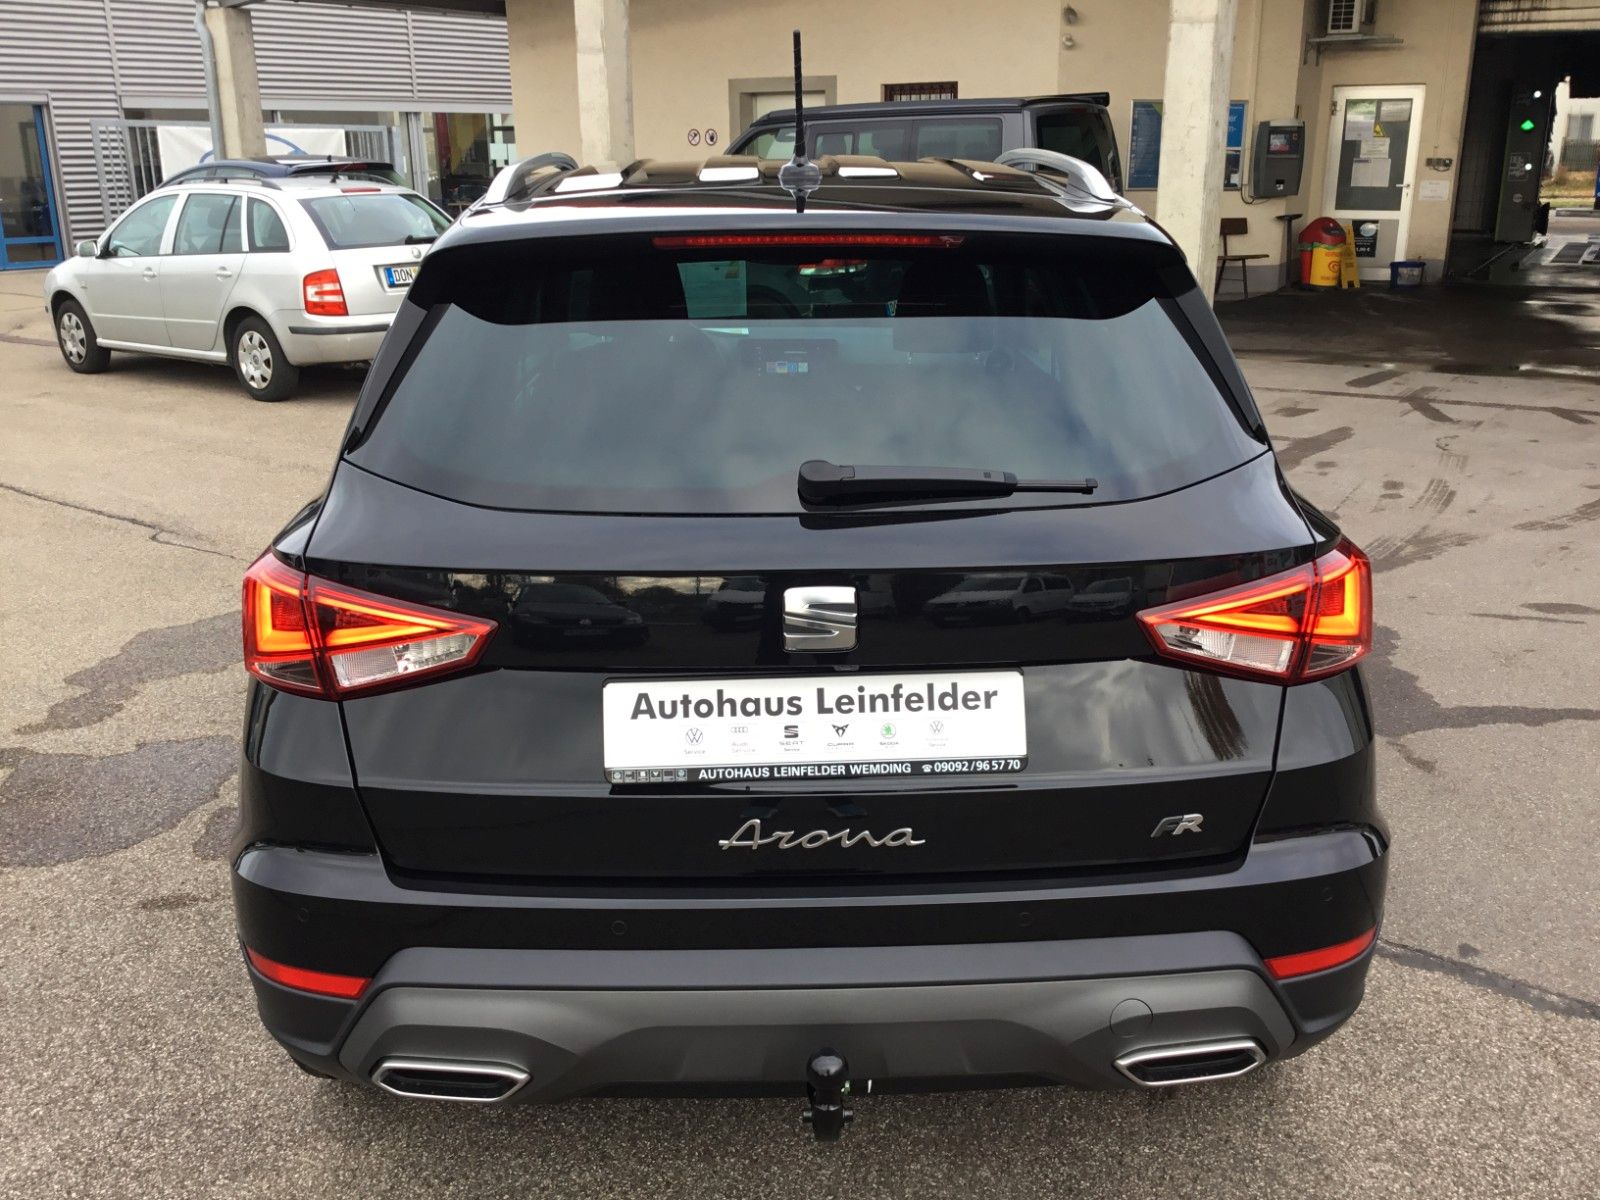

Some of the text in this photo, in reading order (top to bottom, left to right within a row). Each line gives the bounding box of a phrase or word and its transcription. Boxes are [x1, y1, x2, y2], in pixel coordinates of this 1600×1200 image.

[393, 268, 413, 282] DON
[630, 682, 998, 720] Autohaus Leinfelder
[698, 767, 770, 780] AUTOHAUS
[773, 764, 846, 778] LEINFELDER
[850, 762, 912, 775] WEMDING
[718, 818, 926, 850] Arona
[1150, 813, 1204, 838] FR
